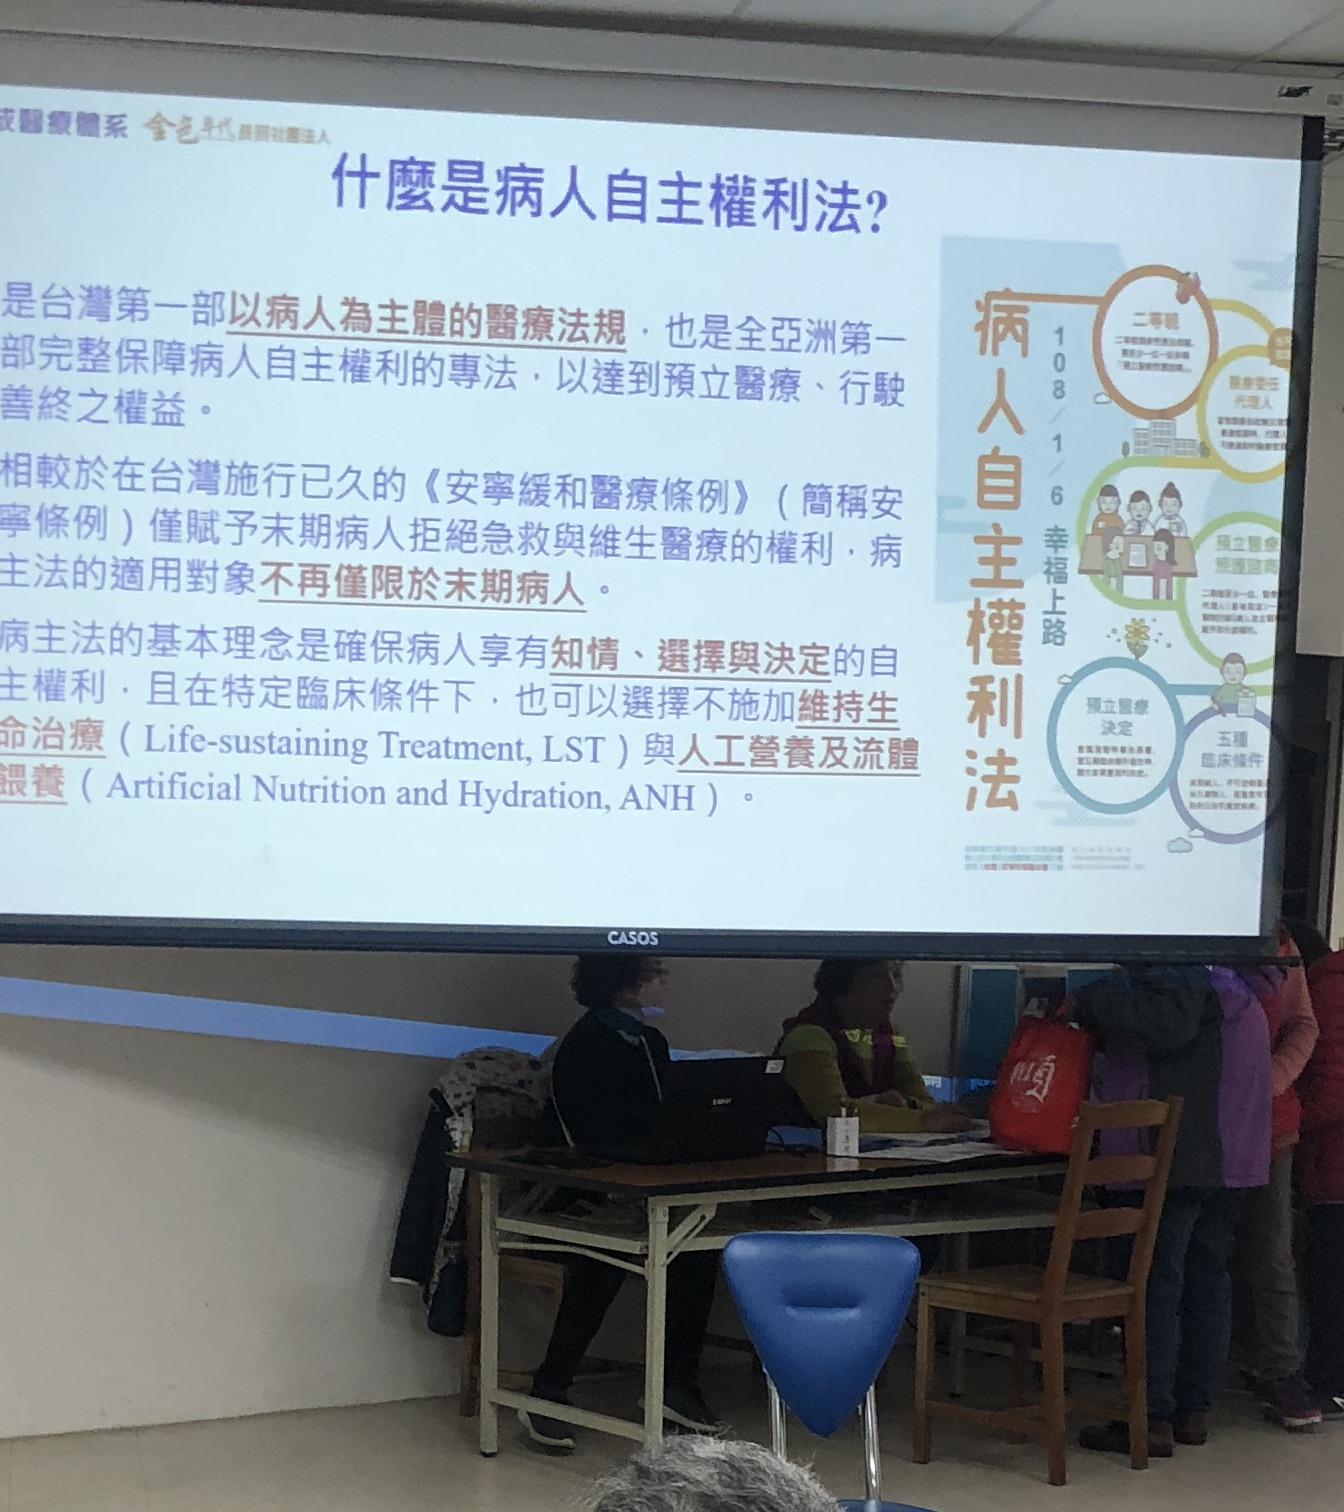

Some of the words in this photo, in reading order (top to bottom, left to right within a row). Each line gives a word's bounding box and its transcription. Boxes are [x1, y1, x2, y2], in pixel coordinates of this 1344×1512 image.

[331, 150, 889, 234] 什麼是病人自主權利法?
[0, 383, 213, 428] 善終之權益。
[965, 287, 1030, 812] 病人自主權利法
[378, 730, 533, 765] Treatment,
[252, 774, 387, 806] Nutrition
[396, 779, 448, 807] and
[459, 780, 612, 814] Hydration,
[606, 929, 660, 947] CASOS
